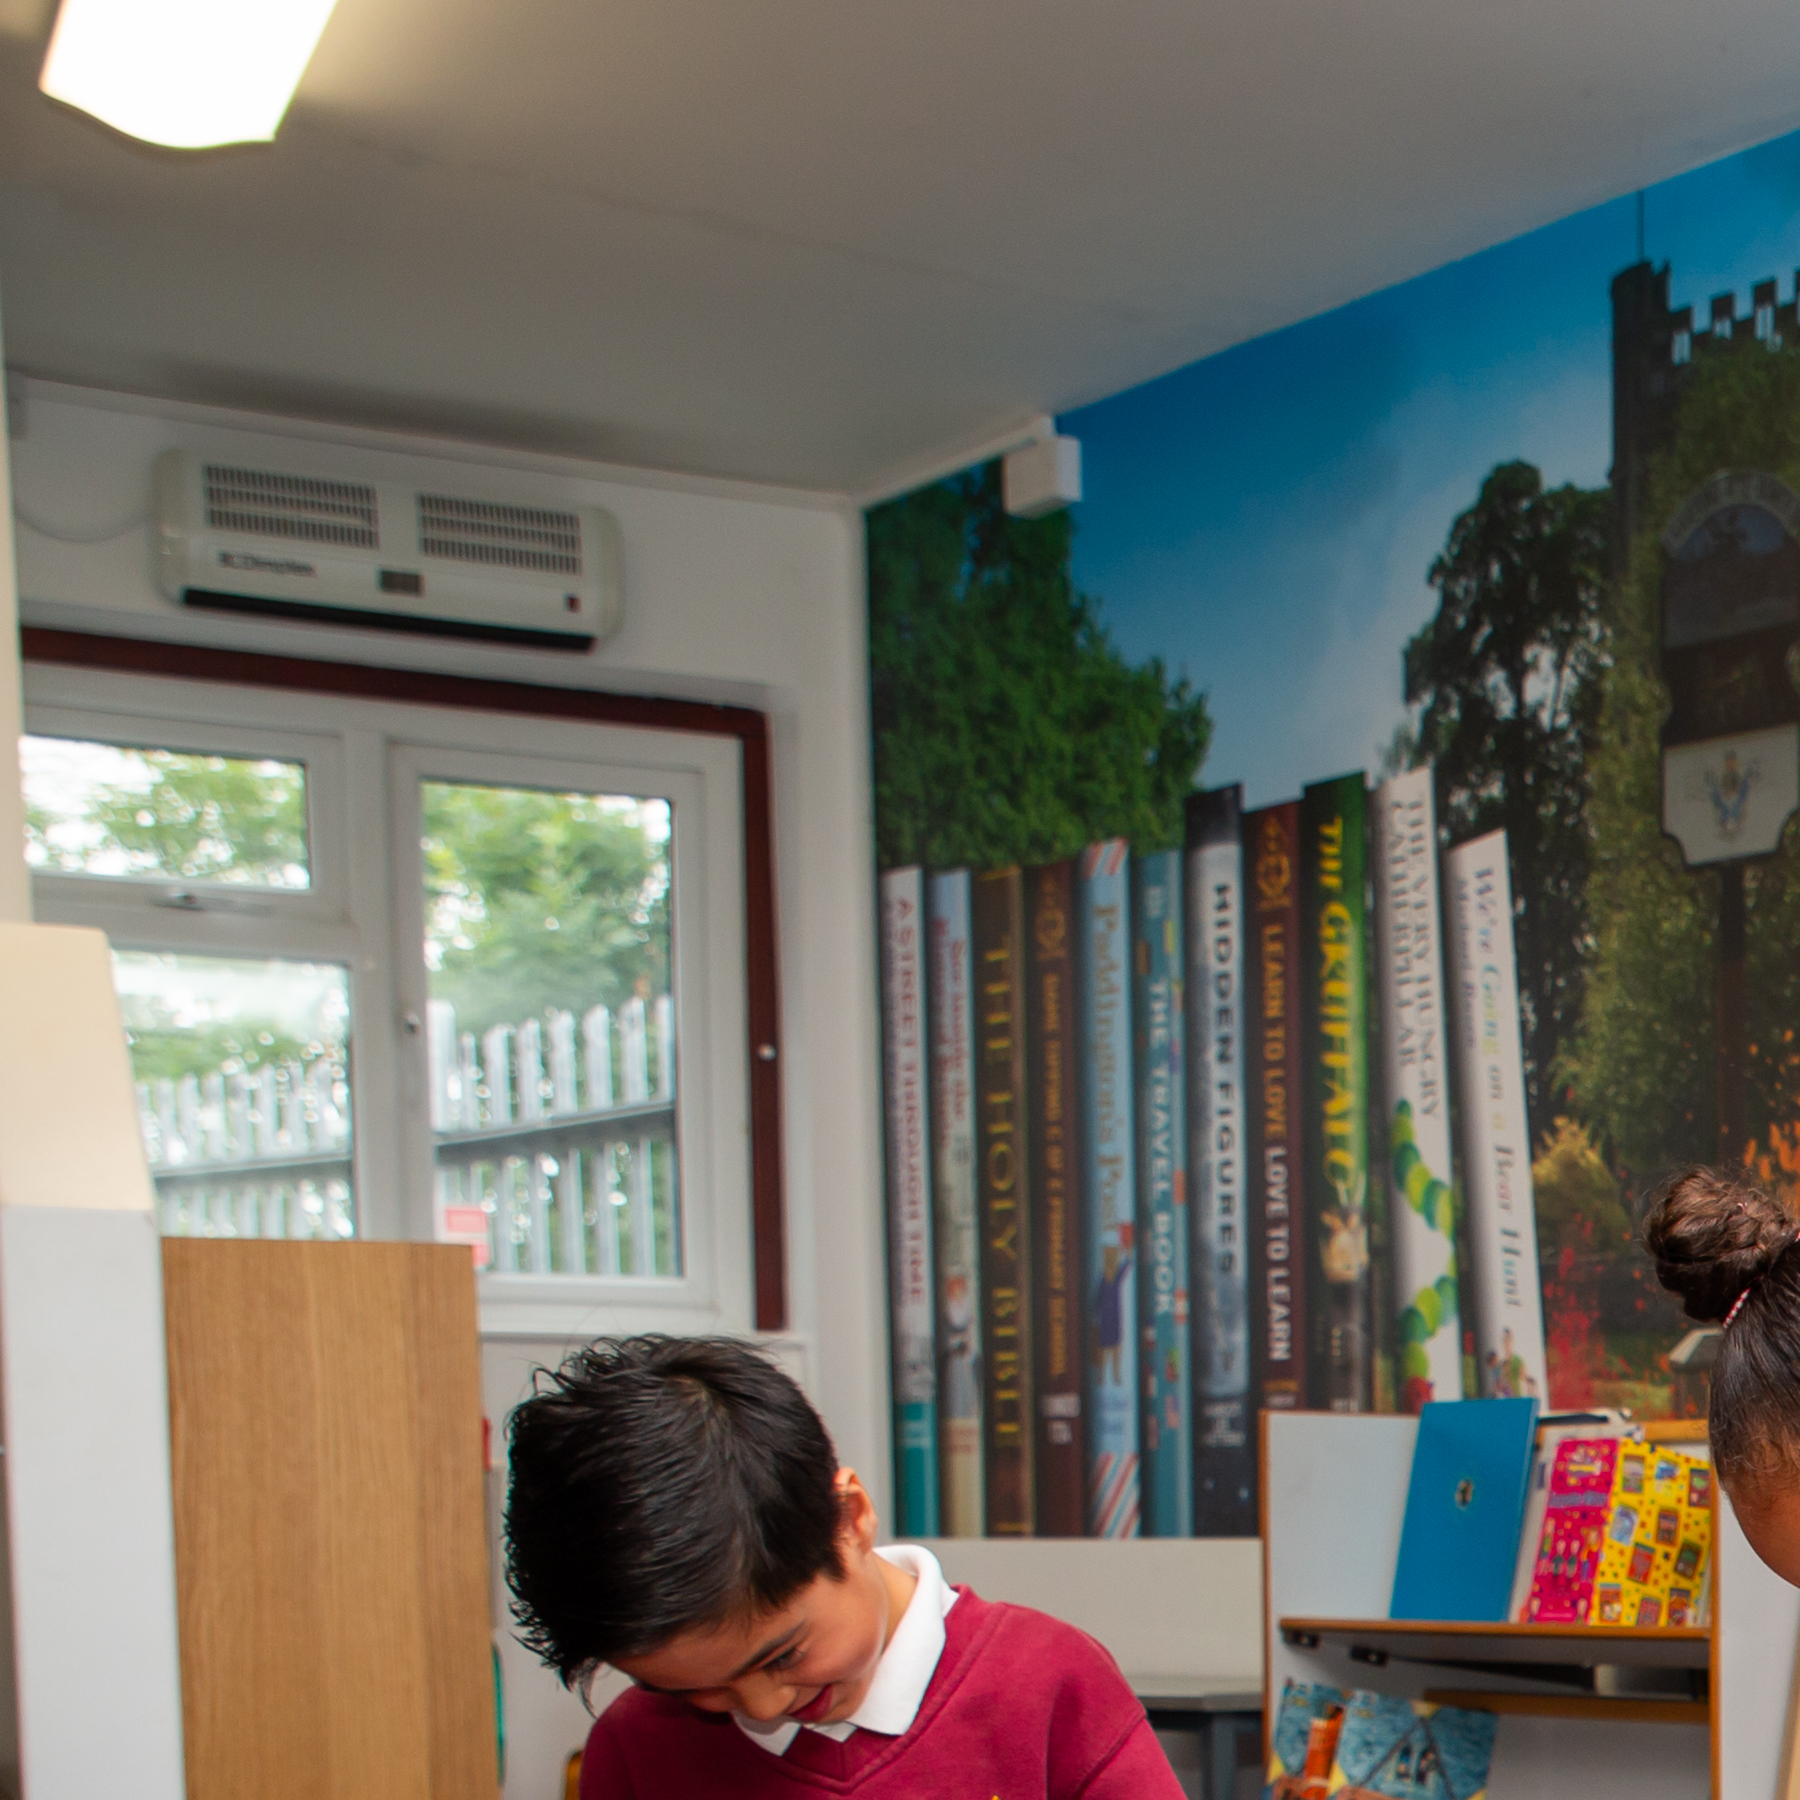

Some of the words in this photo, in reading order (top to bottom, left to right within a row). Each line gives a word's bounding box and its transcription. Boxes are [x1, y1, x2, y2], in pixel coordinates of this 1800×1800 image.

[1318, 815, 1344, 893] THE
[1406, 800, 1426, 867] THE
[898, 897, 916, 919] A
[1409, 873, 1431, 961] VERY
[1474, 867, 1498, 957] We're
[899, 925, 919, 1050] STREET
[983, 933, 1013, 1066] THE
[1149, 978, 1168, 1050] THE
[1212, 882, 1234, 1064] HIDDEN
[1262, 923, 1286, 1020] LEARN
[1481, 963, 1502, 1056] Going
[1092, 903, 1124, 1146] Paddington's
[1264, 1024, 1286, 1062] TO
[1319, 900, 1356, 1187] GRUFFALO
[1415, 973, 1439, 1118] HUNGRY
[1264, 1067, 1288, 1141] LOVE
[1487, 1065, 1504, 1101] on
[902, 1059, 922, 1222] THROUGH
[986, 1090, 1018, 1262] HOLY
[1150, 1063, 1171, 1200] TRAVEL
[1098, 1152, 1125, 1234] Post
[1214, 1080, 1239, 1277] FIGURES
[1264, 1145, 1291, 1220] LOVE
[1494, 1144, 1515, 1211] Bear
[907, 1233, 926, 1304] TIME
[1153, 1211, 1174, 1316] BOOK
[1266, 1225, 1291, 1263] TO
[1499, 1226, 1522, 1308] Hunt
[1267, 1267, 1293, 1362] LEARN
[990, 1286, 1022, 1448] BIBLE
